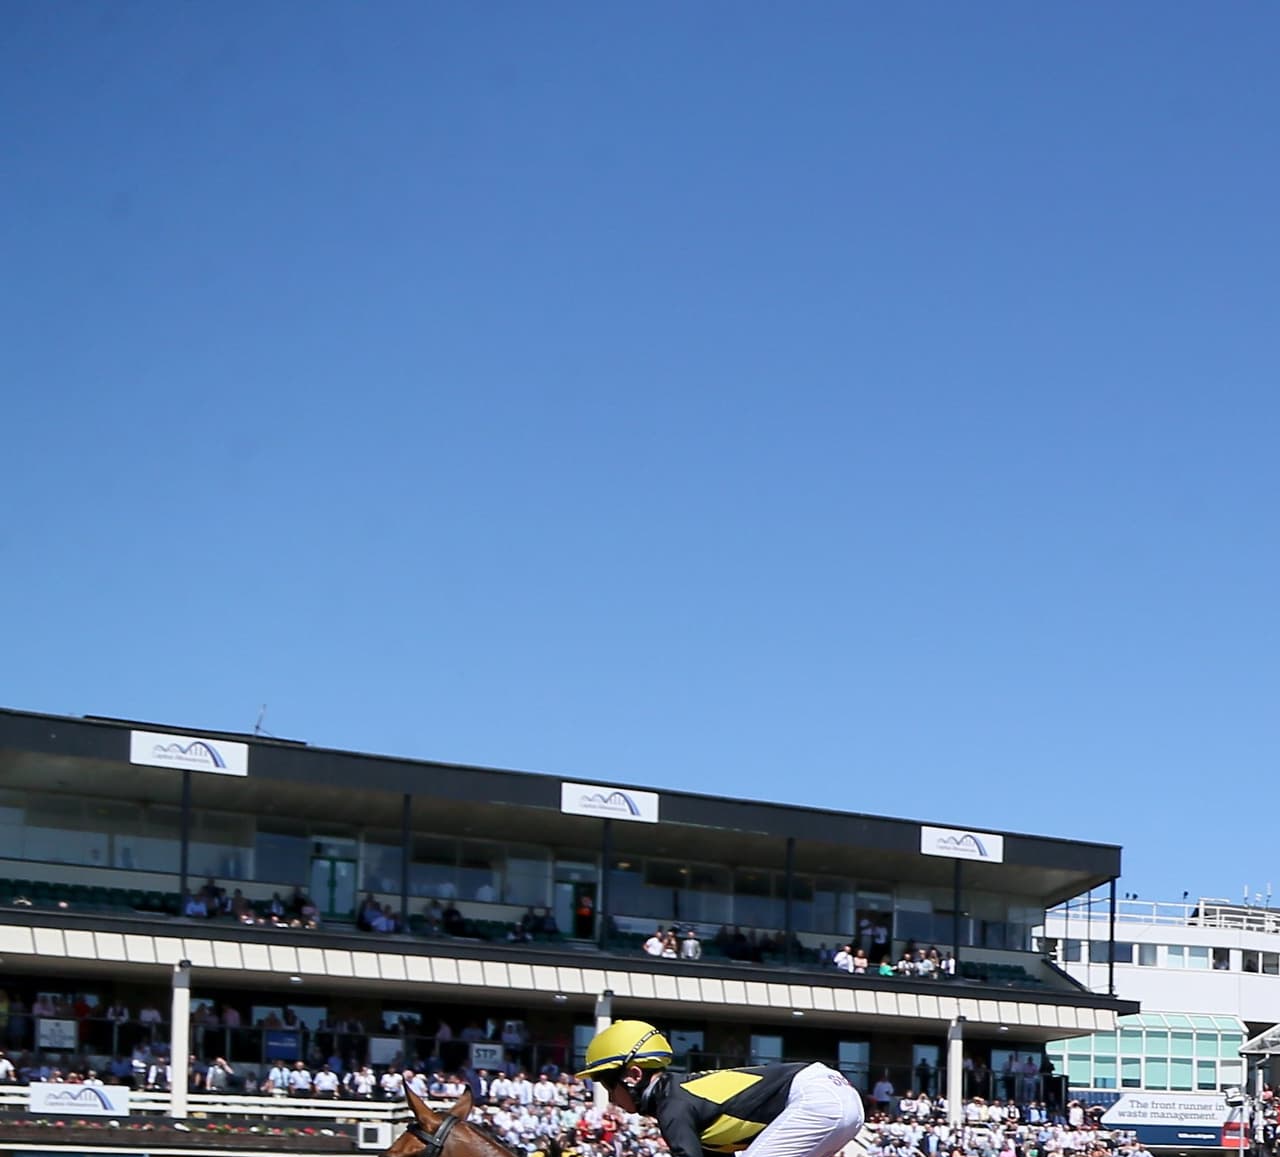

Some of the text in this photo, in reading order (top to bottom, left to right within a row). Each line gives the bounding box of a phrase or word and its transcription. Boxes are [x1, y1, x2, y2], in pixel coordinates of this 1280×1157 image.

[1129, 1099, 1225, 1111] The front runner in
[1118, 1109, 1217, 1121] waste management.
